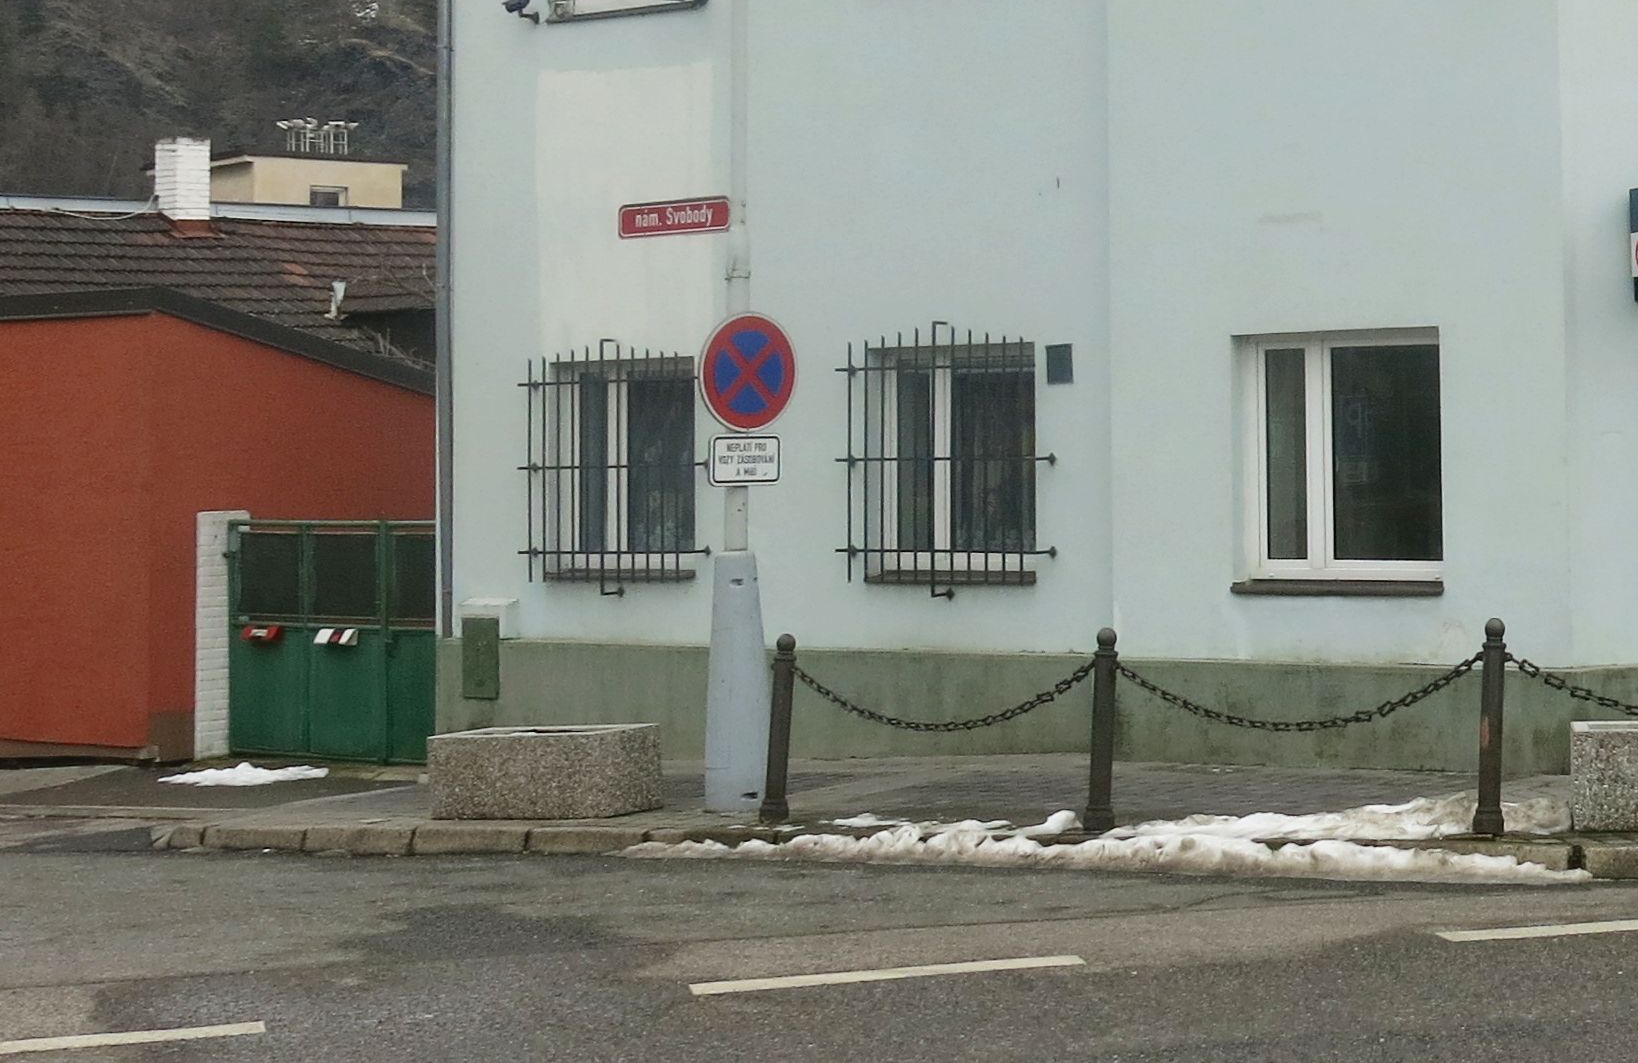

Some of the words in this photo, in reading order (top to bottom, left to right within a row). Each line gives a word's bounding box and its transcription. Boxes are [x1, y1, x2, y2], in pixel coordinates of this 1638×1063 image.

[635, 209, 662, 228] nám.
[666, 204, 713, 226] Svobody
[726, 442, 752, 452] NEPLATÍ
[754, 442, 768, 452] PRO
